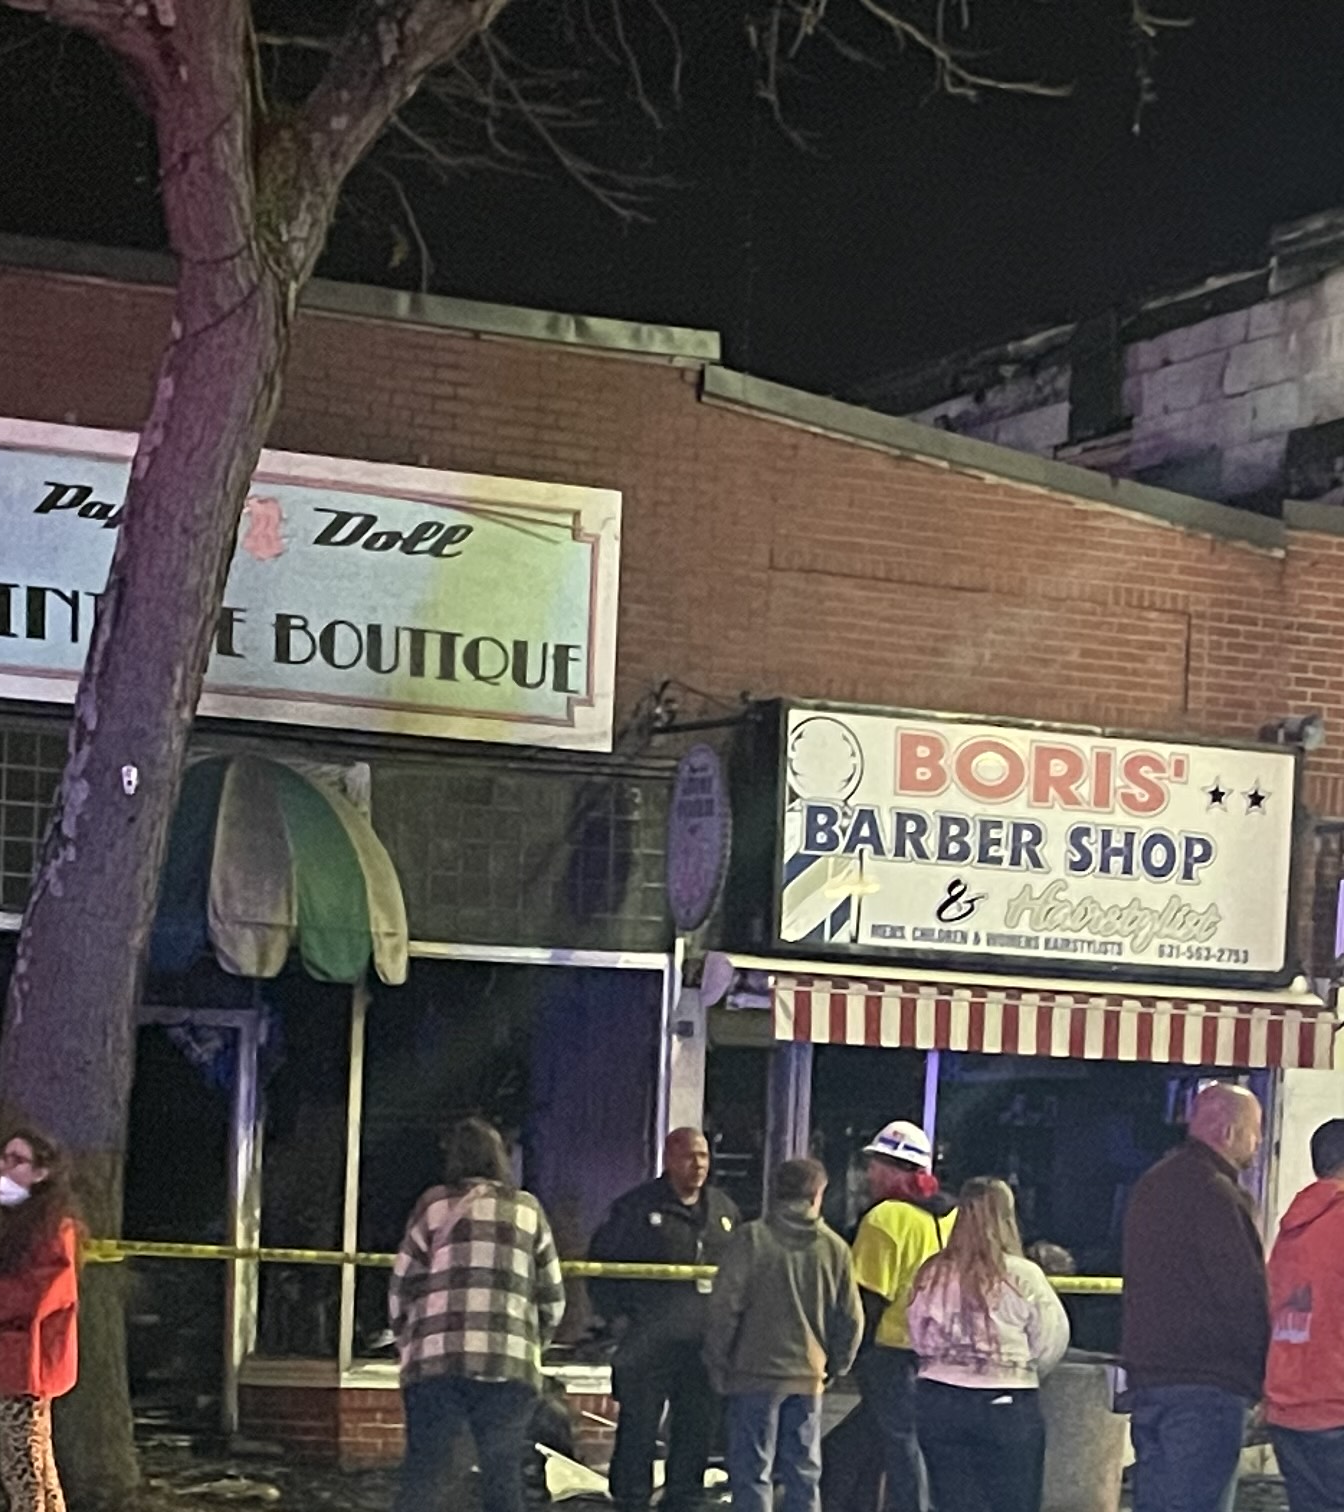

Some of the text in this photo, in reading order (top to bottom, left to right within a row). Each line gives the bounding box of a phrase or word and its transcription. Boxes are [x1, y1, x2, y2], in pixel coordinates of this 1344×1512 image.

[312, 506, 473, 558] Doll
[272, 612, 580, 695] BOUTIQUE
[896, 731, 1190, 814] BORIS'
[803, 804, 1214, 882] BARBER SHOP
[937, 877, 987, 923] &
